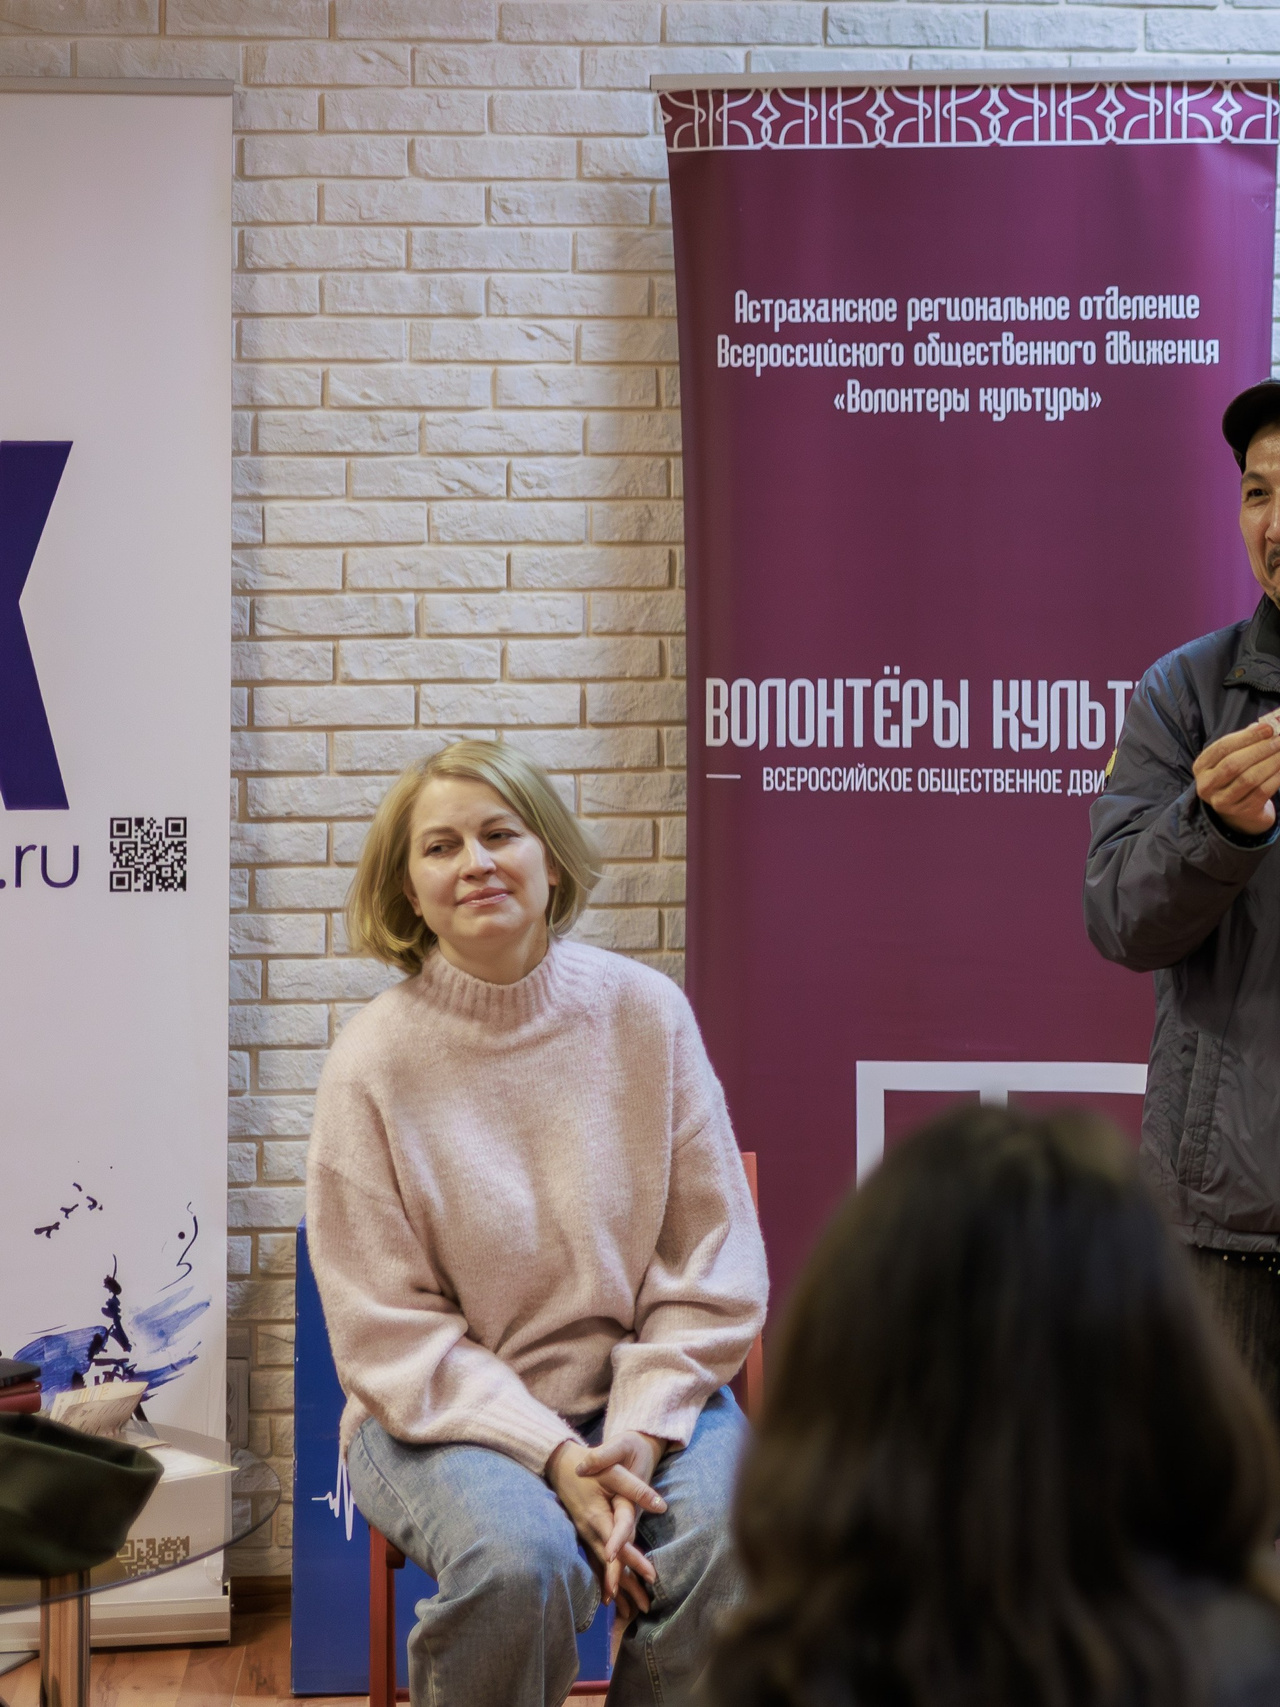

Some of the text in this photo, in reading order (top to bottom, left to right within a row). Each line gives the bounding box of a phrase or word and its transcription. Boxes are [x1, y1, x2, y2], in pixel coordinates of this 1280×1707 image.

[734, 285, 1201, 333] Астраханское региональное отделение
[717, 331, 1221, 377] Всероссийского общественного движения
[833, 379, 1102, 422] «Волонтеры культуры»
[705, 665, 970, 752] ВОЛОНТЁРЫ
[762, 763, 913, 793] ВСЕРОССИЙСКОЕ
[916, 768, 1063, 796] ОБЩЕСТВЕННОЕ
